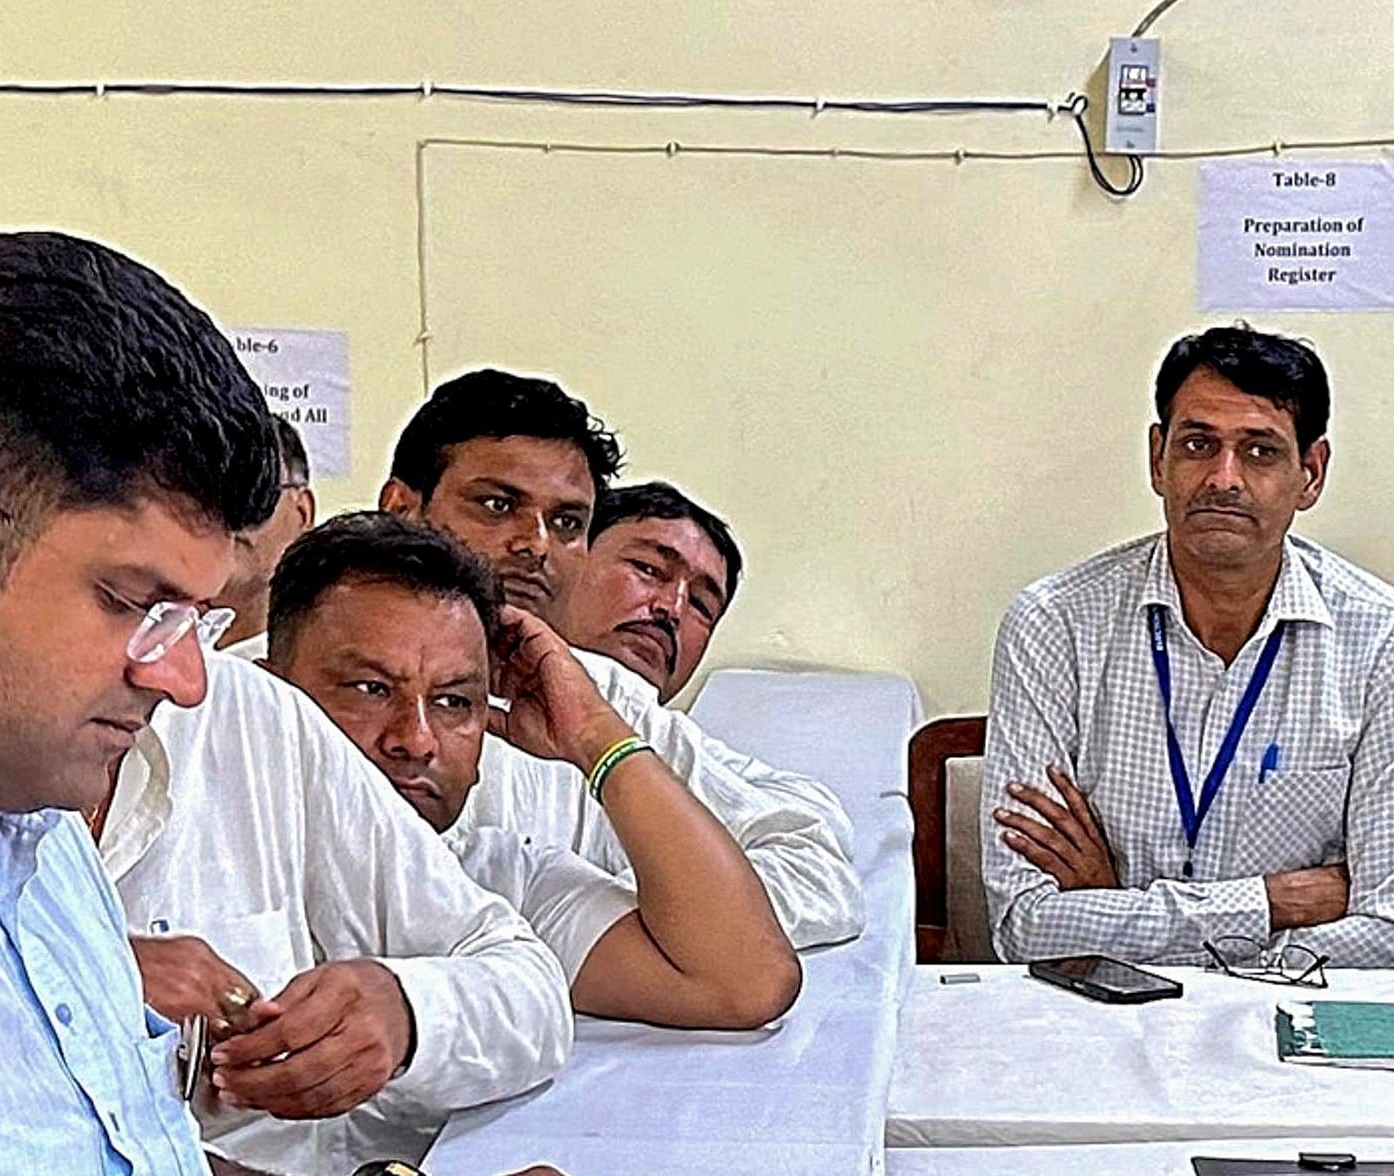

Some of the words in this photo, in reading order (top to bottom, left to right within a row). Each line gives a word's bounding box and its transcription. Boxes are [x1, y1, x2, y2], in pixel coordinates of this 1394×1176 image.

[1273, 172, 1337, 187] Table-8
[1243, 217, 1343, 236] Preparation
[1346, 217, 1364, 233] of
[1254, 242, 1351, 258] Nomination
[1268, 267, 1337, 285] Register
[292, 384, 310, 399] of
[304, 408, 328, 423] All
